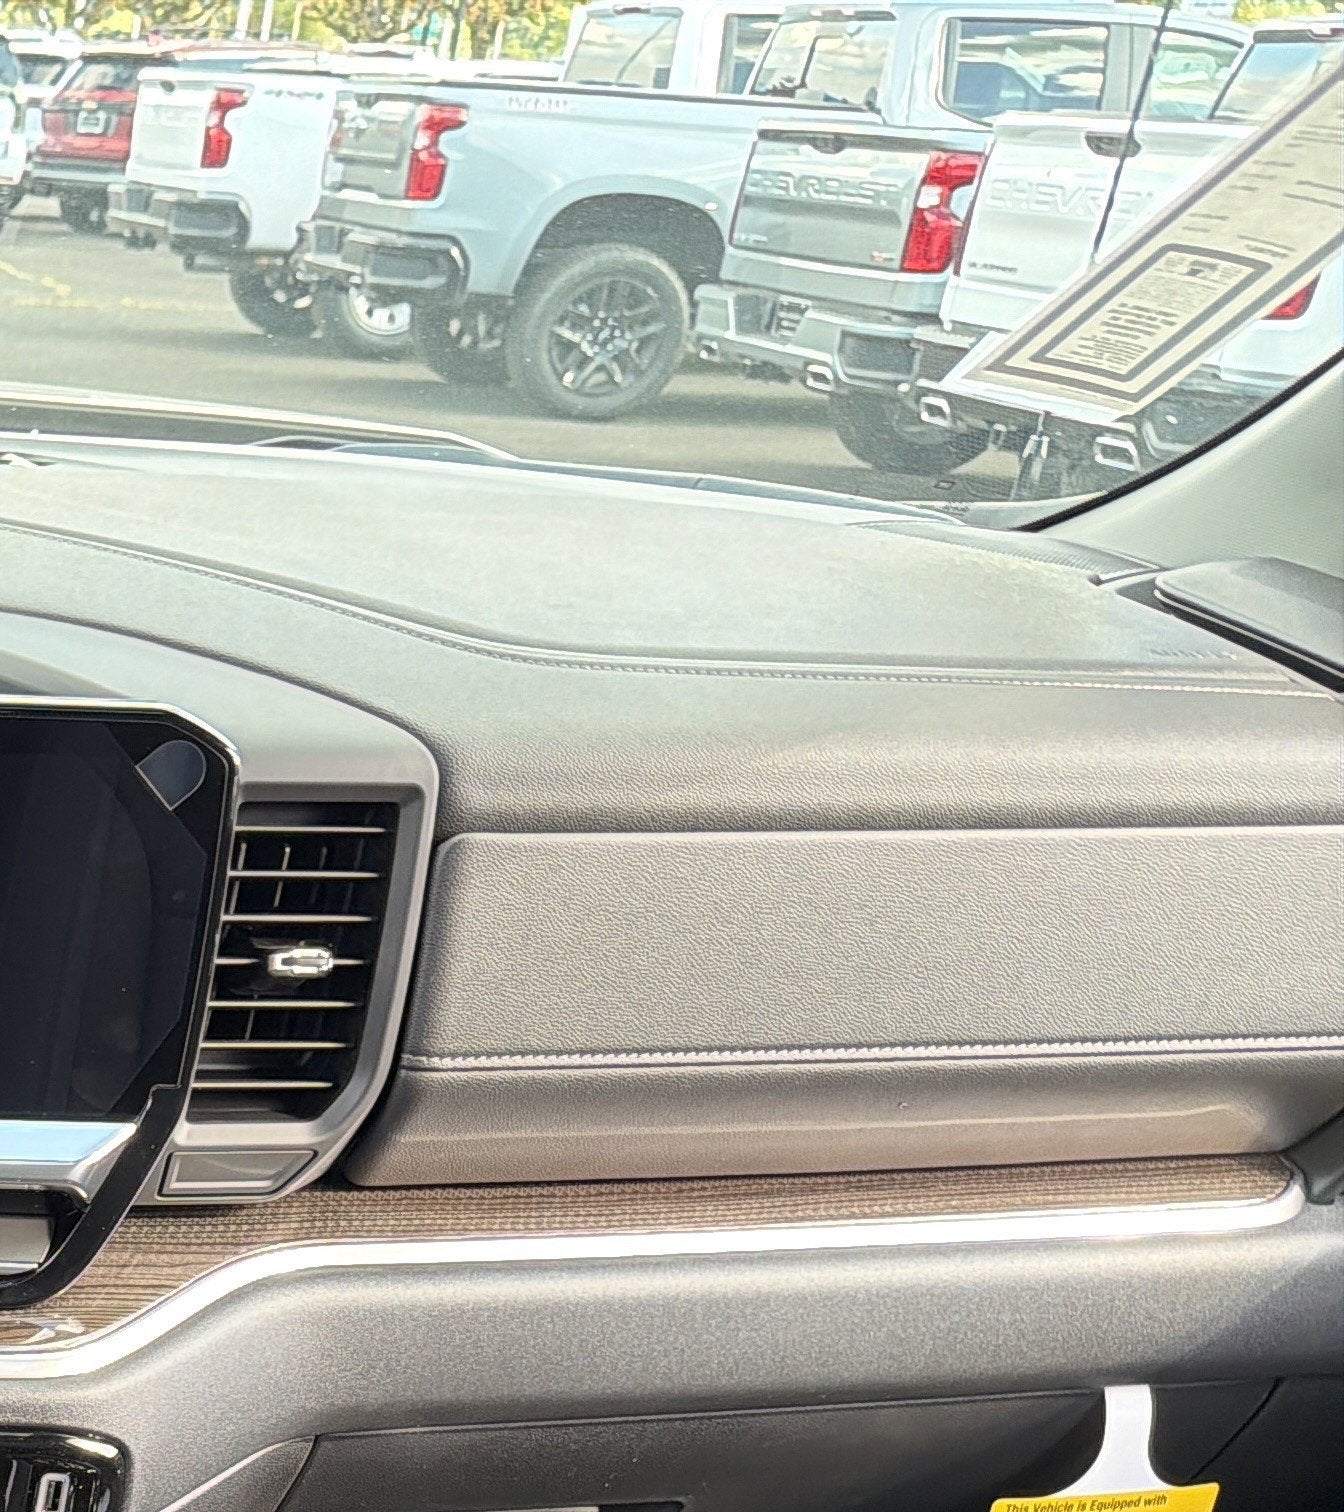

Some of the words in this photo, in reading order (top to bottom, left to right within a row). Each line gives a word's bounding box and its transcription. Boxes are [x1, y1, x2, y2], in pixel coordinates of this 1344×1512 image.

[1076, 1501, 1087, 1512] is
[1090, 1496, 1140, 1512] Equipped
[1144, 1494, 1168, 1507] with
